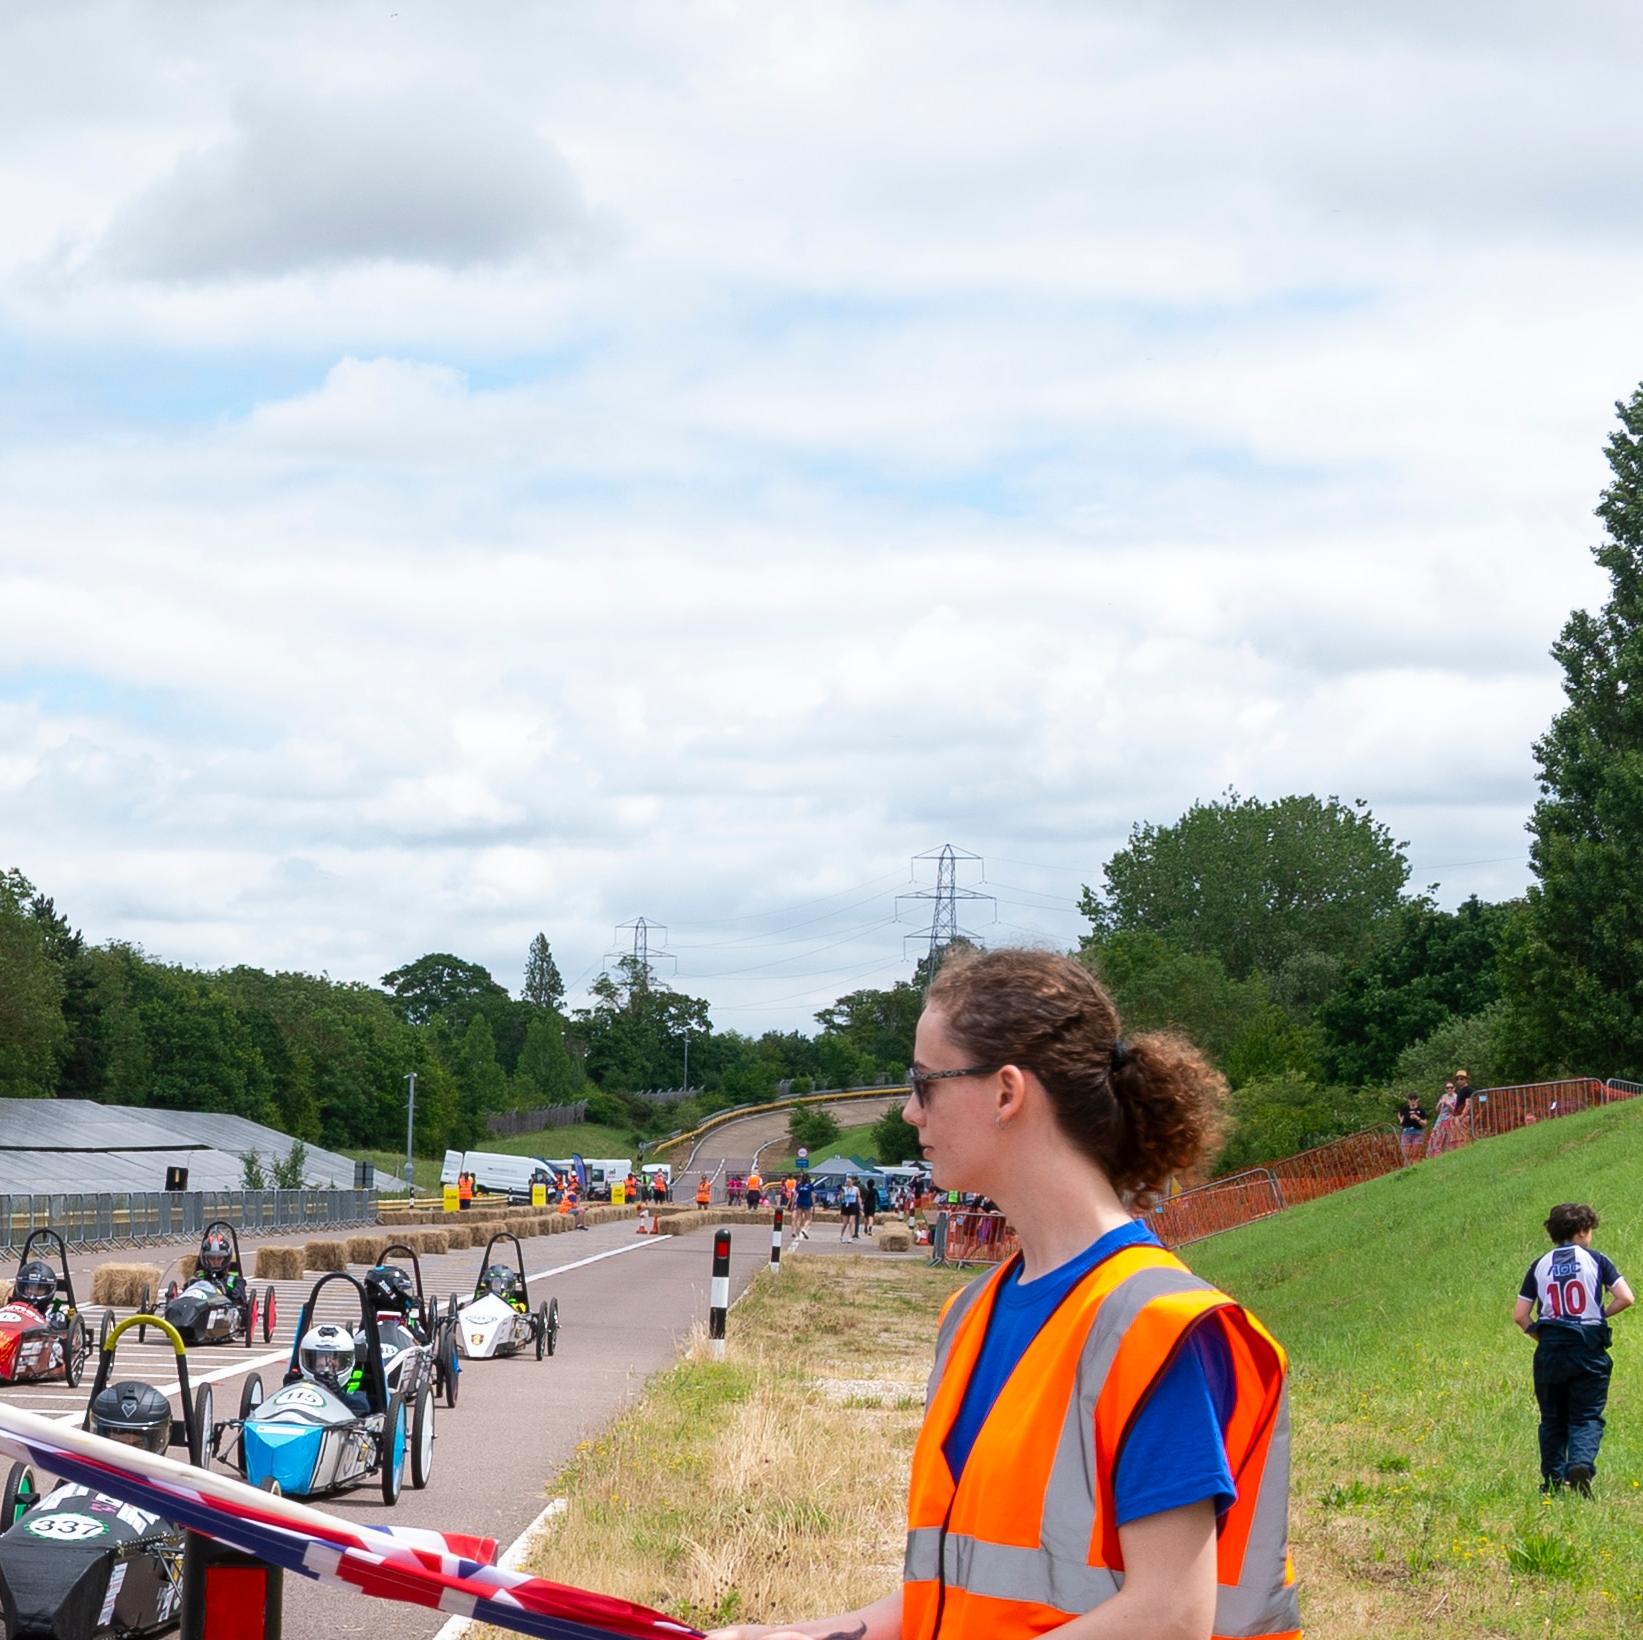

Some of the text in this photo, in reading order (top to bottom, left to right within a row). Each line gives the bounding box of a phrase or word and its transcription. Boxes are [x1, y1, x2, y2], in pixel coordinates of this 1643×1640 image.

[1546, 1279, 1587, 1318] 10
[286, 1391, 317, 1404] 115
[35, 1519, 104, 1536] 337
